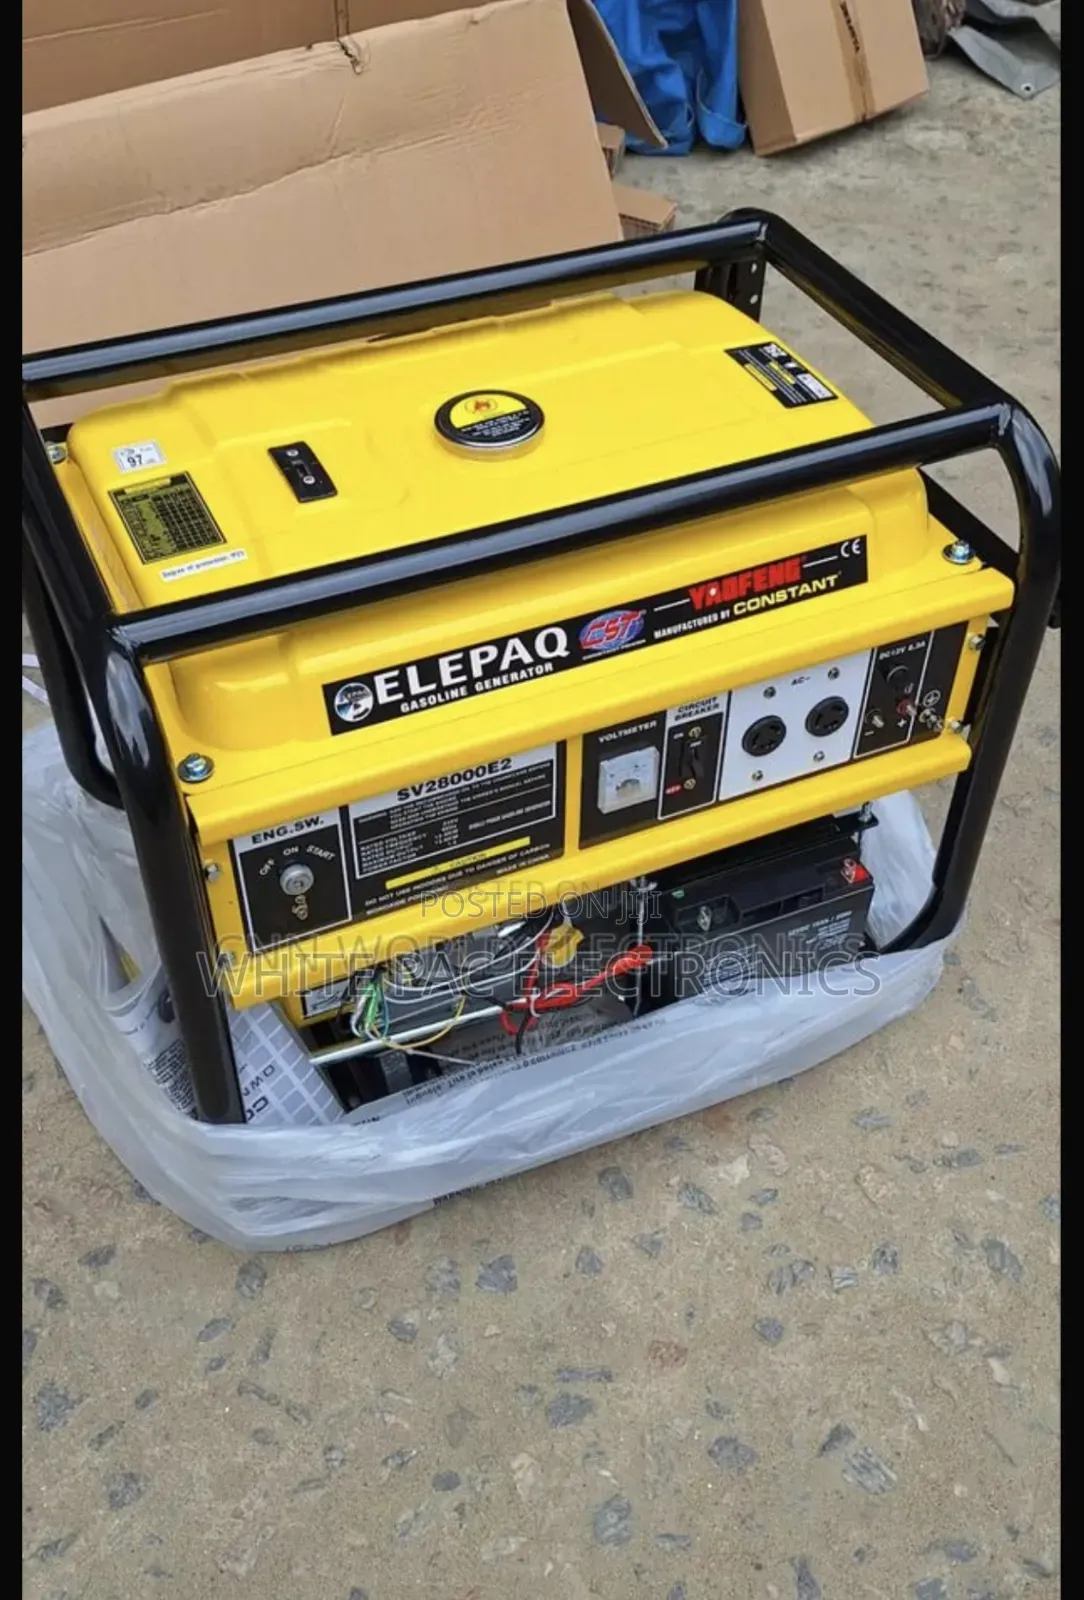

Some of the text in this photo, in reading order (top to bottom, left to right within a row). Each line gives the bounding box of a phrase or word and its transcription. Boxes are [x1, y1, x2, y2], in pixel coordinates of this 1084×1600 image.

[653, 573, 839, 639] MANUFACTURED BY CONSTANT
[373, 626, 570, 705] ELEPAQ
[400, 662, 554, 714] GASOLINE GENERATOR
[598, 720, 657, 743] VOLTMETER
[396, 757, 513, 802] SV28000E2
[251, 816, 324, 844] ENG.SW.
[283, 845, 336, 861] ON START
